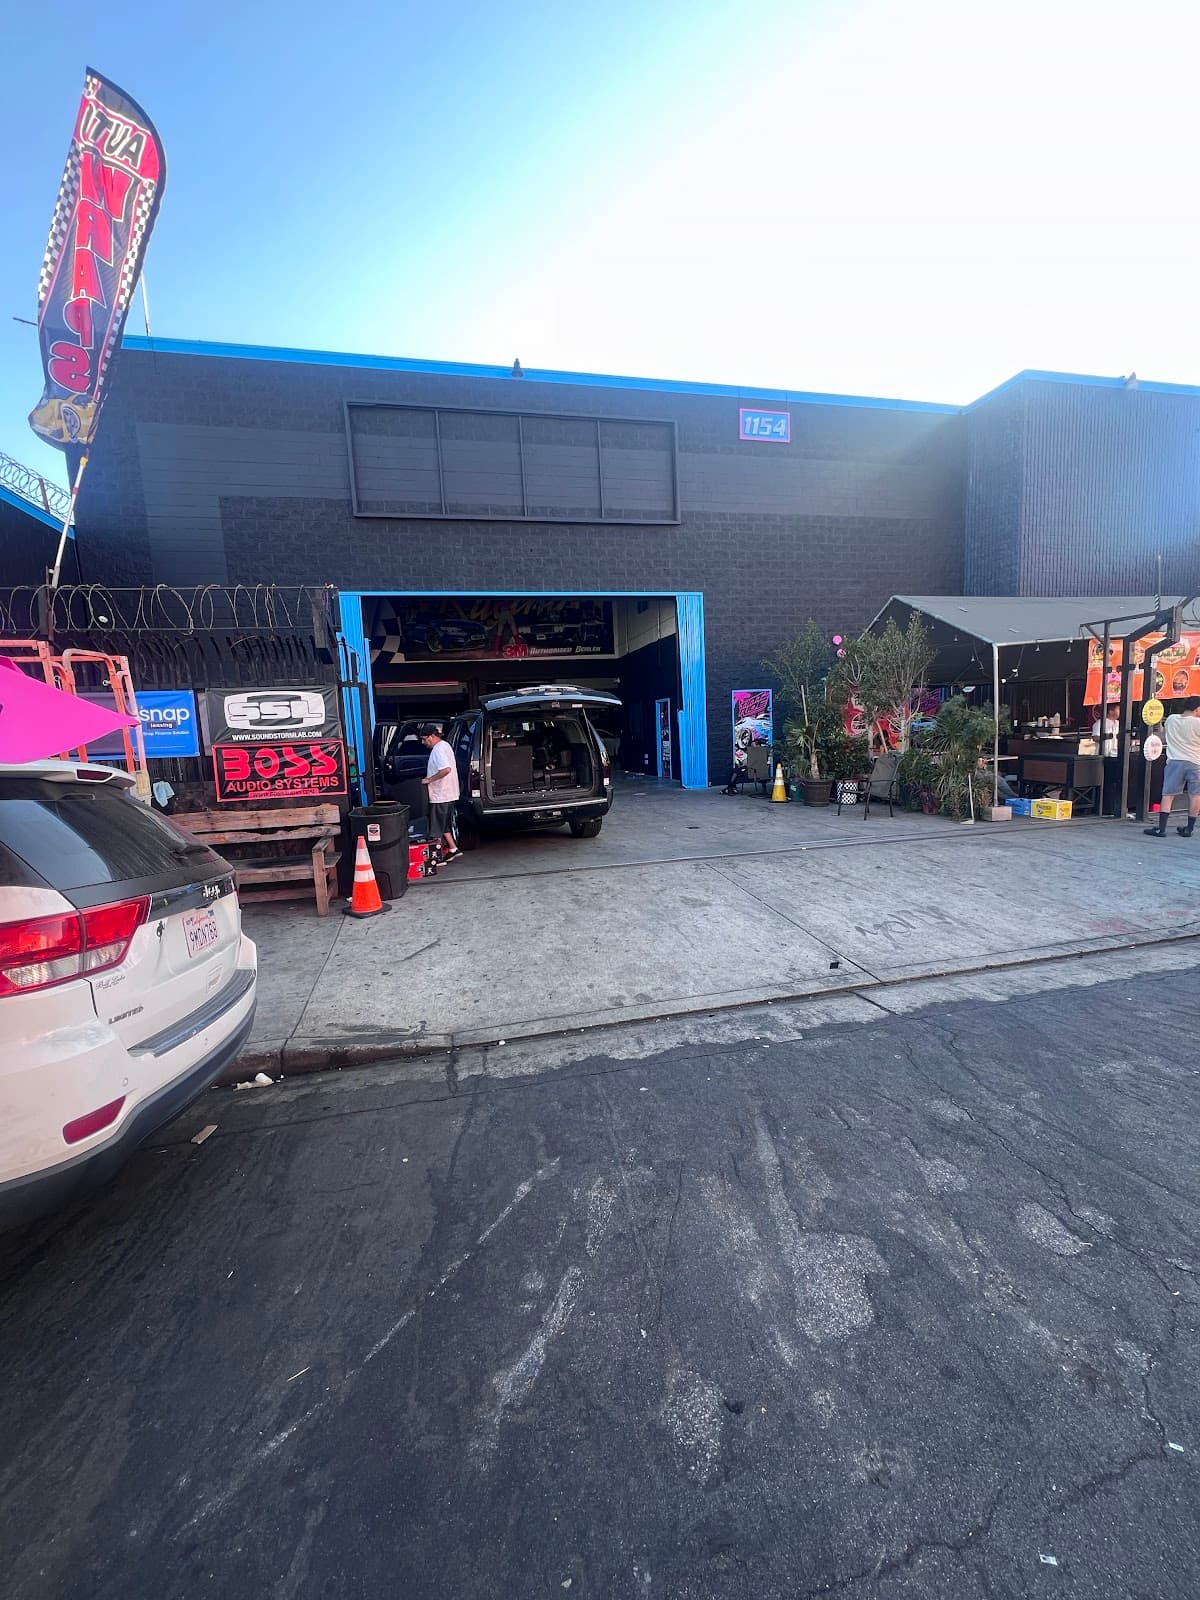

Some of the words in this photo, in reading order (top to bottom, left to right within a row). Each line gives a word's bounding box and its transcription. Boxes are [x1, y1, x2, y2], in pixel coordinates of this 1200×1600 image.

[744, 417, 787, 436] 1154
[503, 644, 528, 659] 3M
[140, 708, 190, 725] snap
[232, 731, 322, 740] WWW.SOUNDSTORMLAB.COM
[222, 745, 338, 781] BOSS
[226, 780, 271, 792] AUDIO
[275, 776, 339, 789] SYSTEMS
[202, 885, 221, 900] Jeep
[108, 1006, 144, 1025] LIMITED
